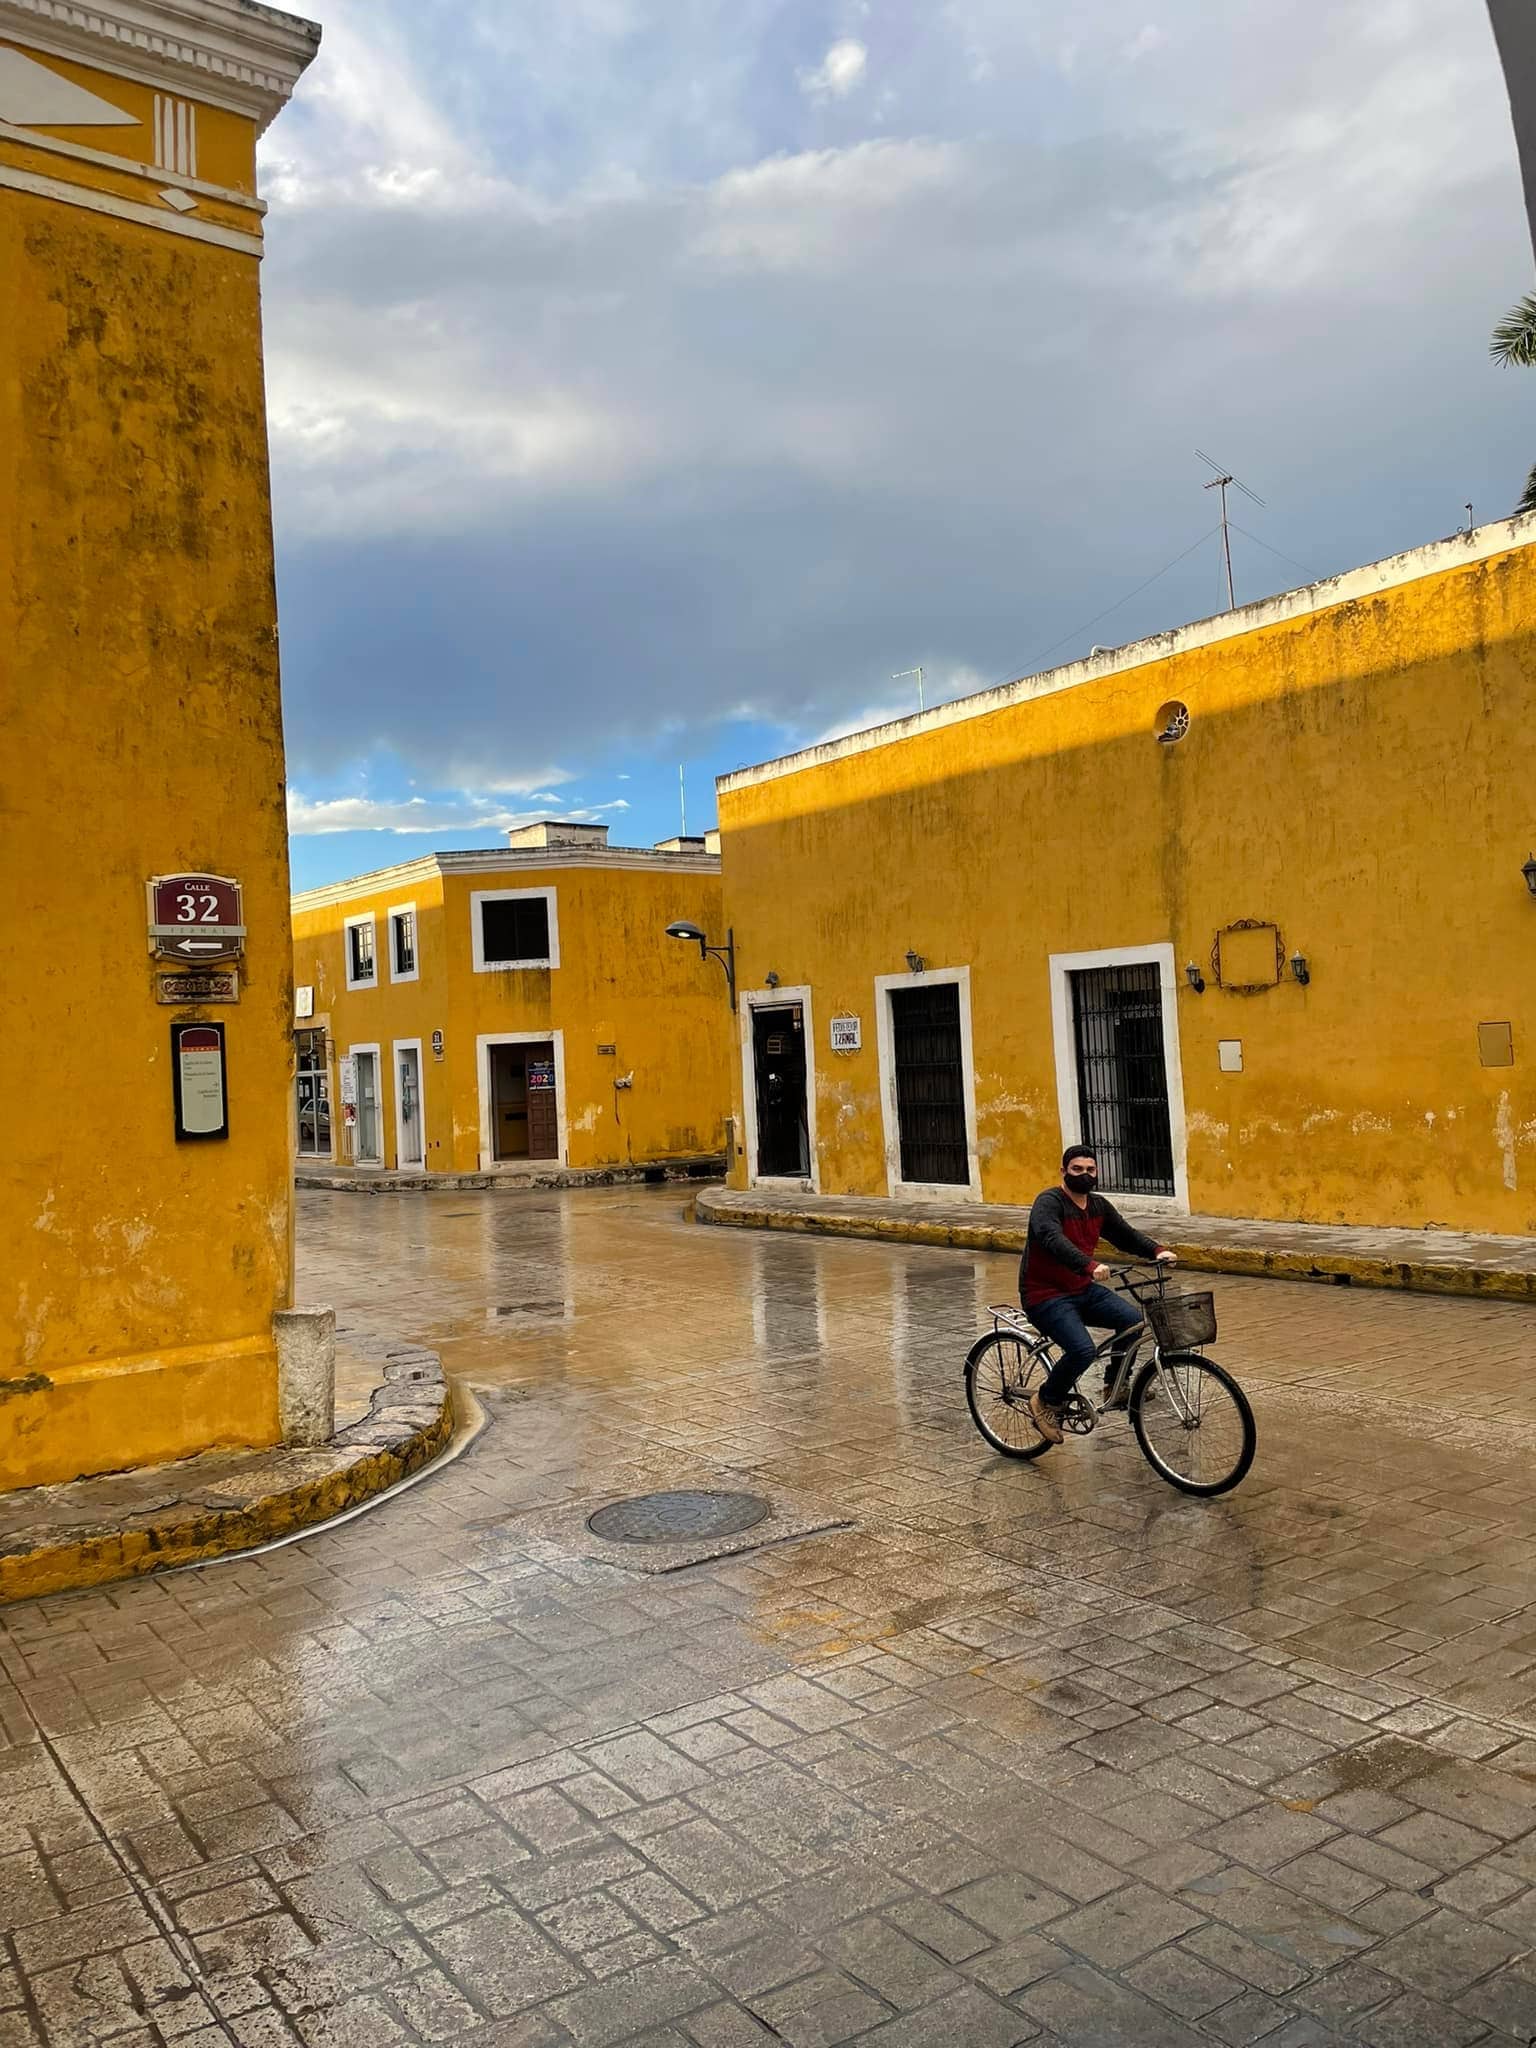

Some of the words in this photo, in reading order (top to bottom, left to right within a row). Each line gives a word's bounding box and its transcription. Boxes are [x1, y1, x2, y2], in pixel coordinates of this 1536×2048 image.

[184, 882, 211, 892] CALLE
[176, 894, 219, 922] 32
[530, 1074, 554, 1083] 2020
